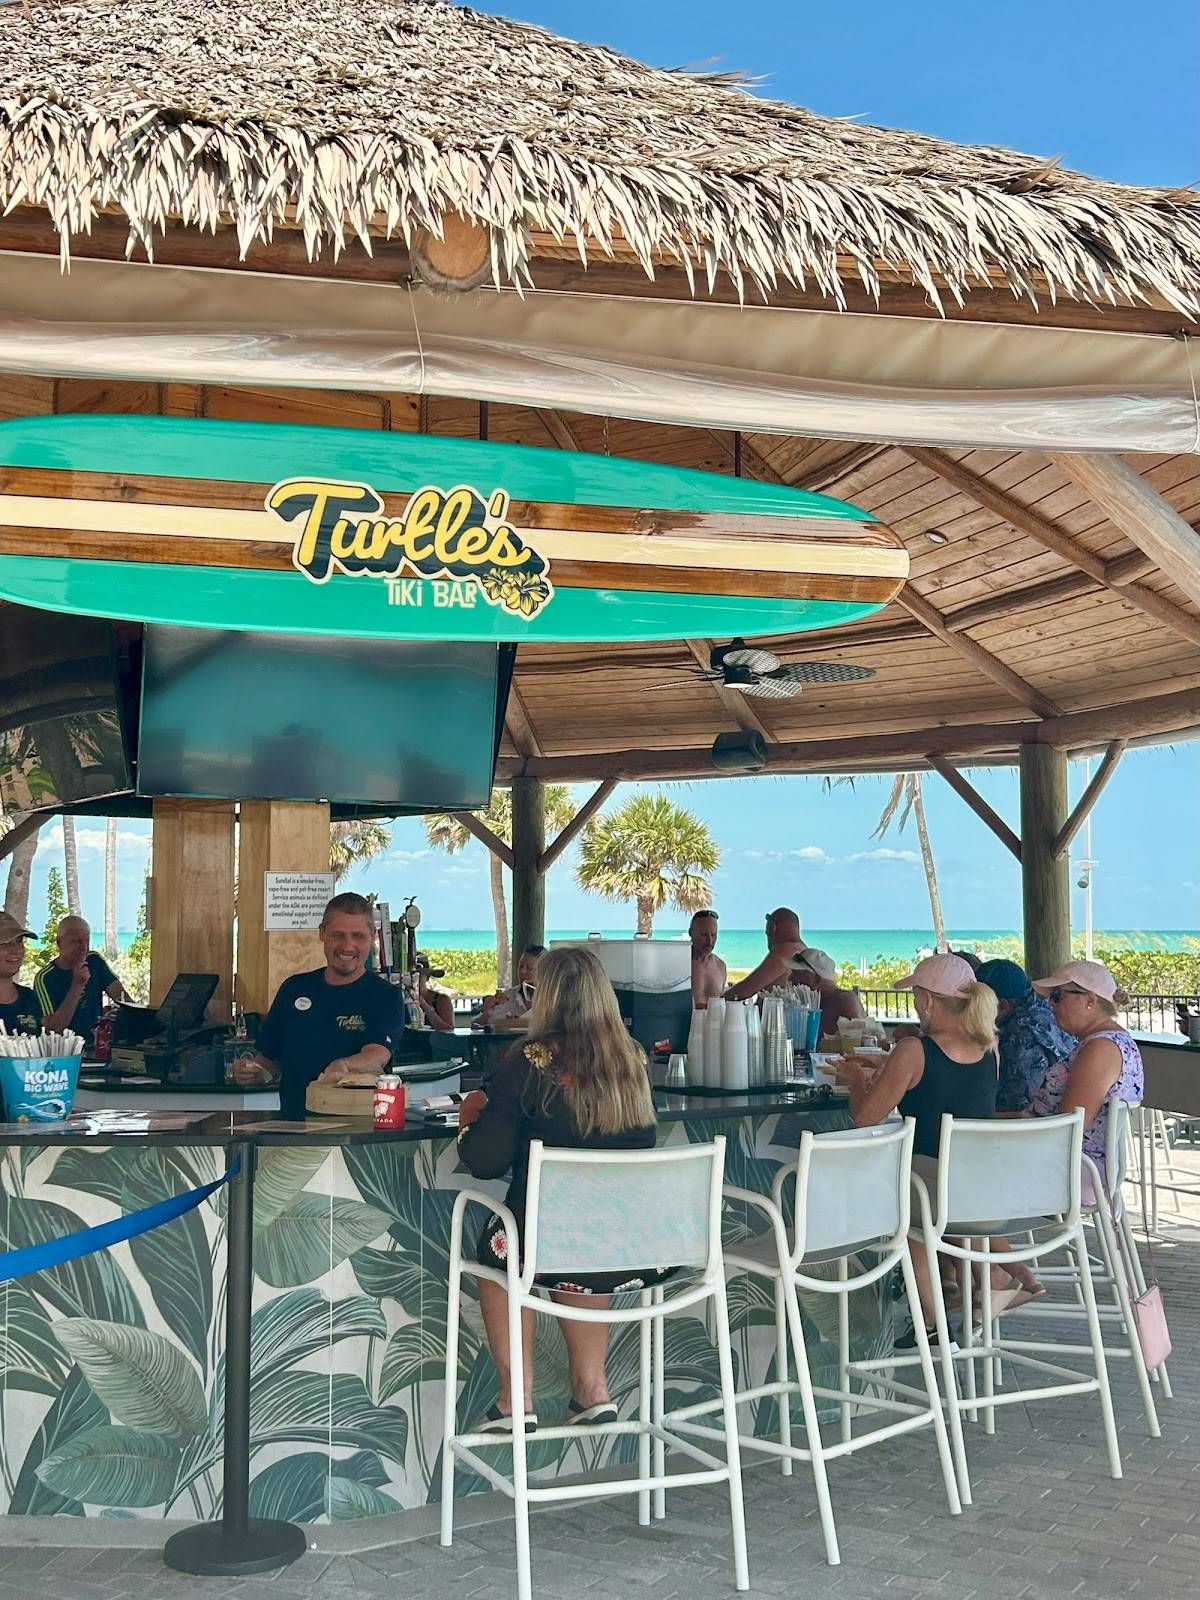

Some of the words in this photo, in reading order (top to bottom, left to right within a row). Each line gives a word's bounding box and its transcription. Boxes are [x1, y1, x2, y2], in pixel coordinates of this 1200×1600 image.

[268, 479, 548, 581] Turtle's
[431, 580, 477, 609] BAR
[24, 1070, 69, 1085] KONA
[24, 1084, 42, 1092] BIG
[43, 1082, 69, 1092] WAVE
